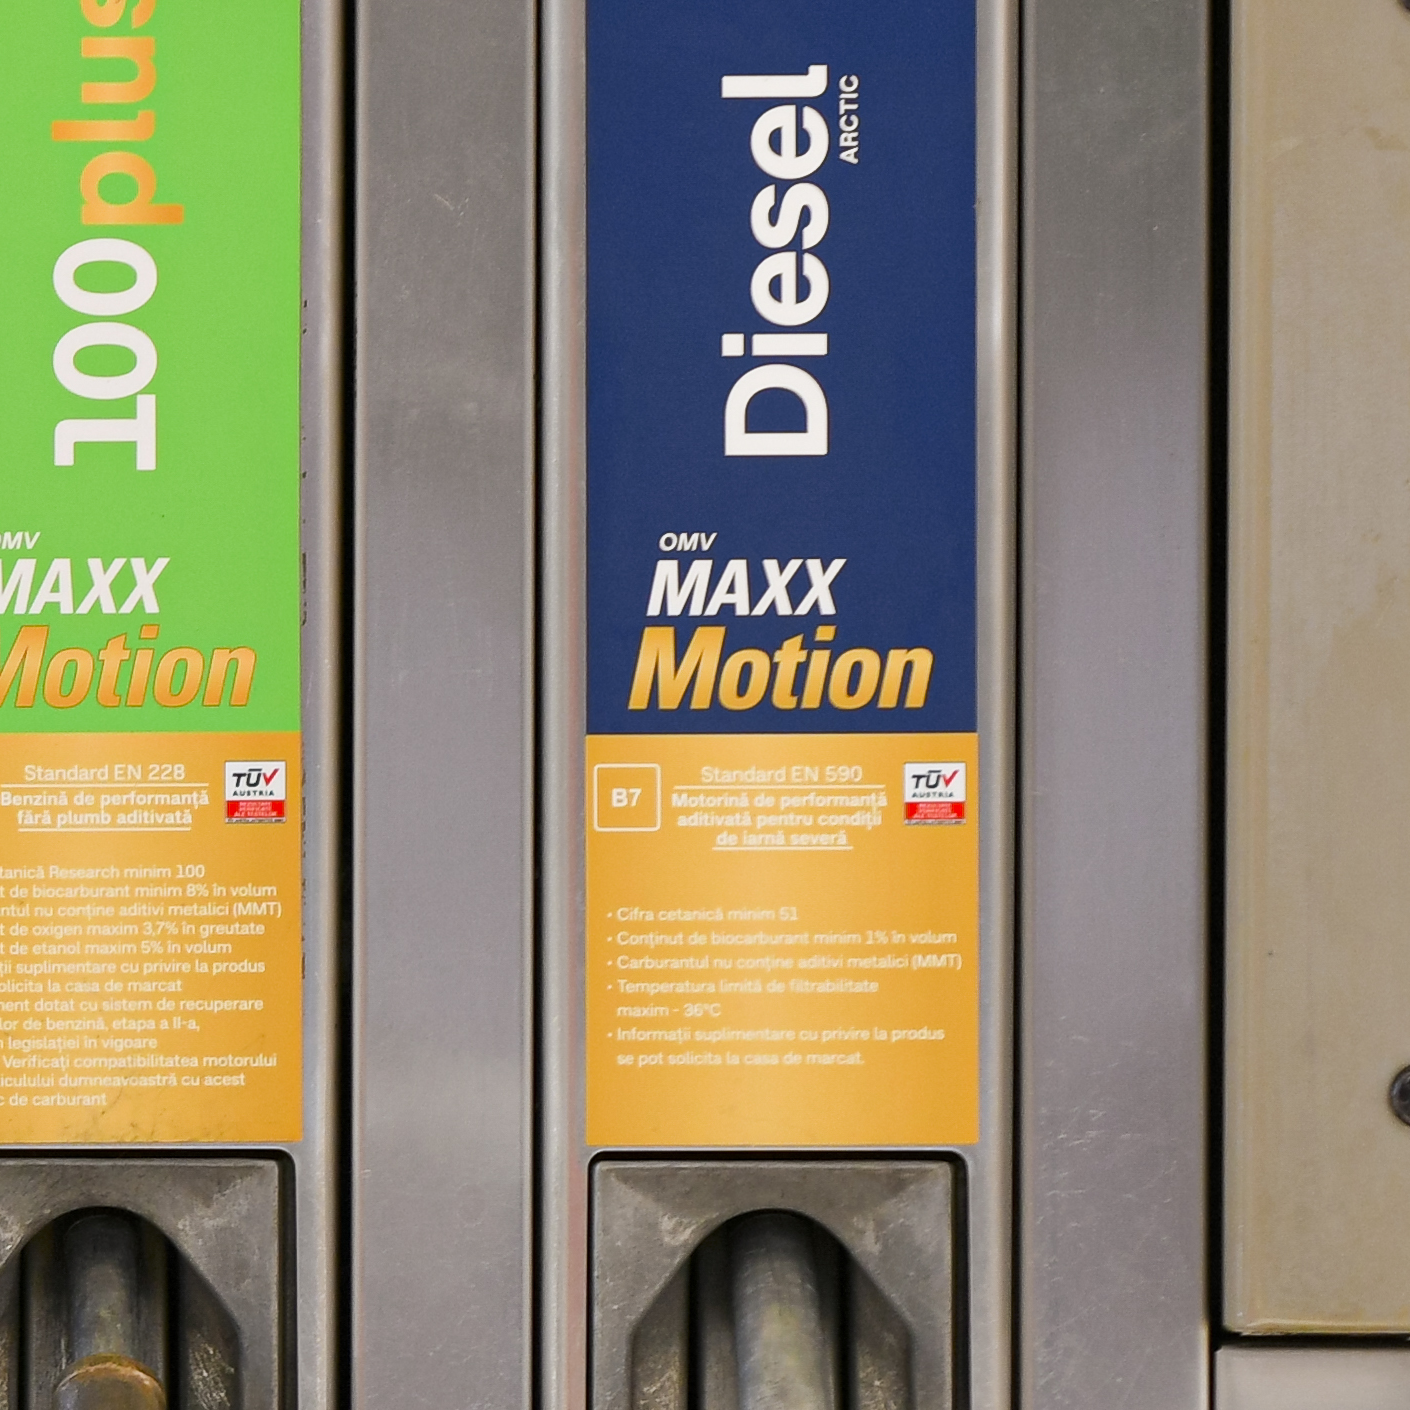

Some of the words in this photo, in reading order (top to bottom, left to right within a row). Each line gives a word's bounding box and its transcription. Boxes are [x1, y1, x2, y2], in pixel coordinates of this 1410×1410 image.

[838, 74, 860, 165] ARCTIC
[721, 64, 830, 457] Diesel
[658, 532, 717, 551] OMV
[646, 557, 847, 617] MAXX
[627, 624, 935, 711] Motion
[24, 764, 109, 782] Standard
[114, 764, 142, 782] EN
[148, 764, 186, 781] 228
[701, 766, 787, 784] Standard
[791, 766, 820, 784] EN
[825, 765, 863, 783] 590
[73, 790, 95, 807] de
[611, 788, 641, 808] B7
[753, 792, 777, 808] de
[56, 810, 112, 828] plumb
[756, 812, 815, 830] pentru
[716, 831, 739, 847] de
[48, 865, 121, 880] Research
[123, 865, 172, 879] minim
[176, 864, 206, 879] 100
[617, 907, 655, 922] Cifra
[727, 907, 777, 922] minim
[777, 906, 800, 922] 51
